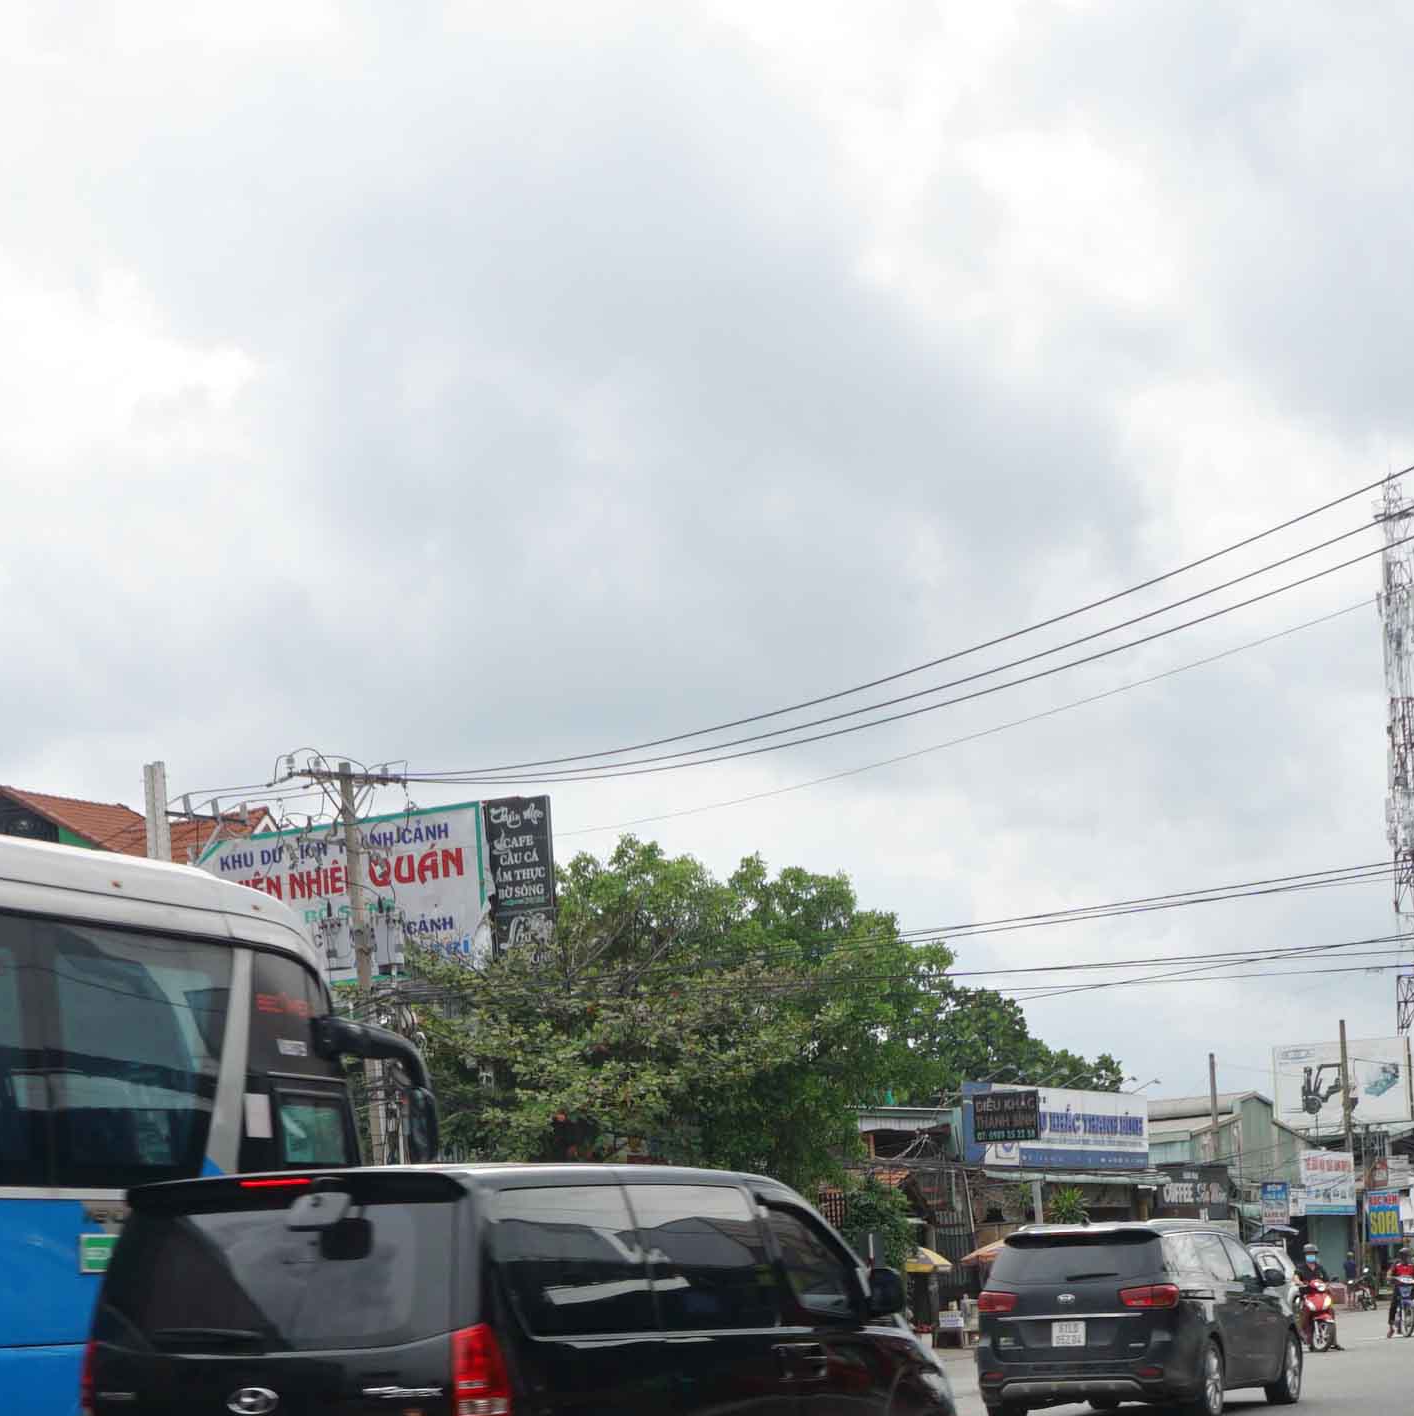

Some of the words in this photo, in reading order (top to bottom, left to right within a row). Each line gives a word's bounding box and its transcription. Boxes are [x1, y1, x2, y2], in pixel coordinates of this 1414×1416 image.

[219, 853, 255, 873] KHU
[400, 818, 450, 847] CẢNH
[503, 834, 535, 849] CAFE
[288, 860, 350, 902] NHIÊ
[368, 844, 465, 888] QUÁN
[514, 866, 546, 884] THỰC
[1162, 1182, 1195, 1205] COFFEE
[1369, 1210, 1400, 1236] SOFA
